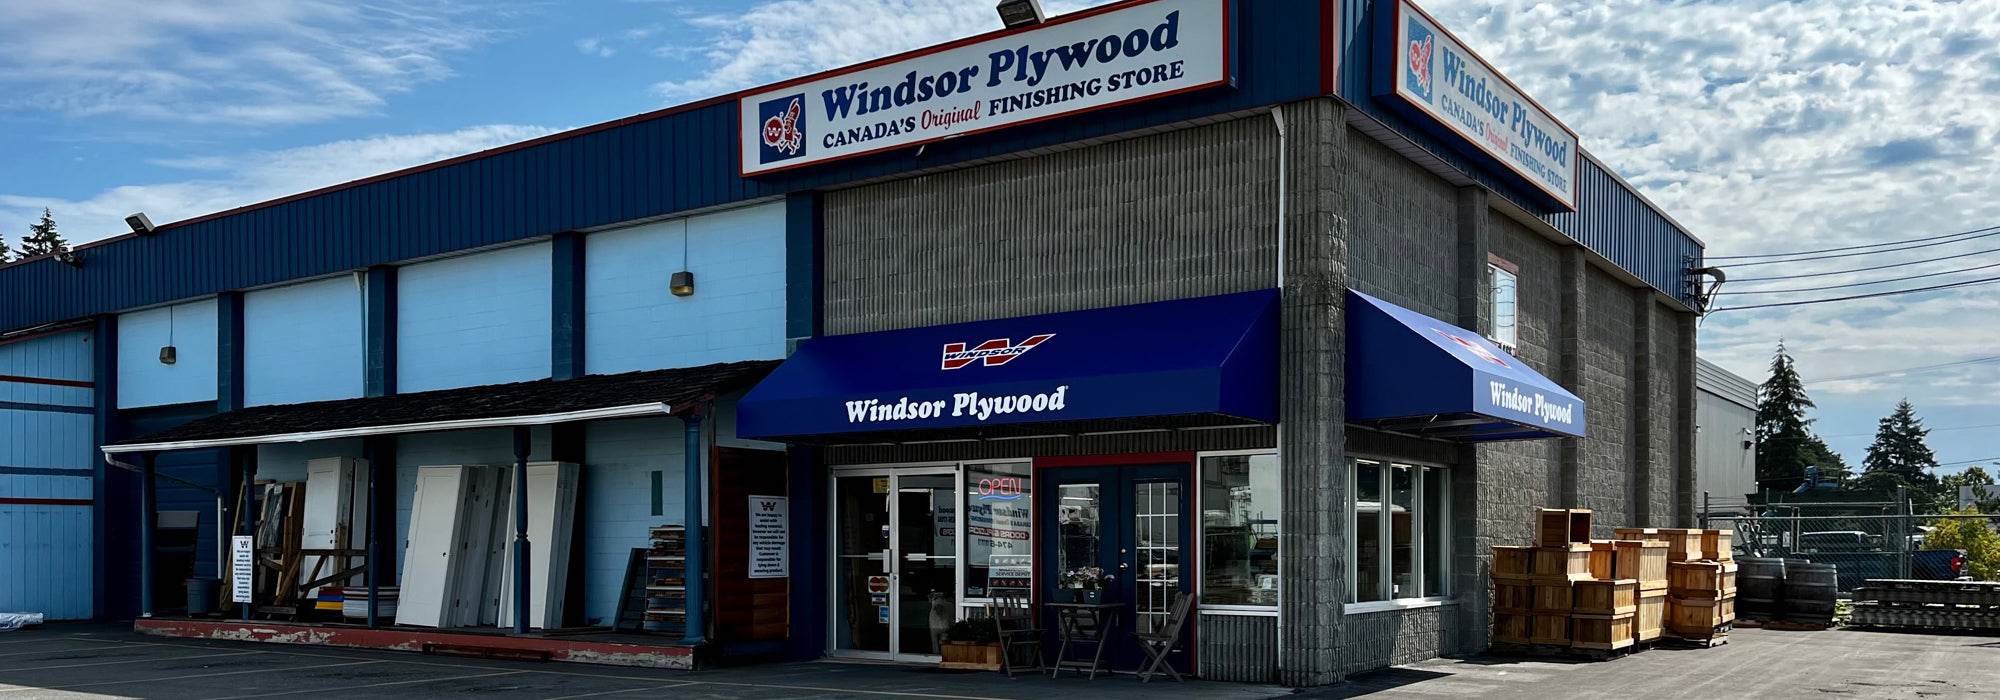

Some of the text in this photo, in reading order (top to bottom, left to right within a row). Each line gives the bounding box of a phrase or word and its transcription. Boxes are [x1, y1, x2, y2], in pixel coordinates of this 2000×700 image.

[822, 10, 1180, 122] Windsor Plywood
[822, 60, 1184, 149] CANADA'S Original FINISHING STORE
[1442, 46, 1567, 168] Windsor Plywood
[1441, 94, 1484, 136] CANADA'S
[1510, 143, 1546, 178] FINISHING
[1547, 169, 1567, 194] STORE
[944, 347, 1026, 360] WINDSOR
[846, 386, 1066, 423] Windsor Plywood
[1490, 381, 1572, 424] Windsor Plywood
[978, 478, 1022, 495] OPEN
